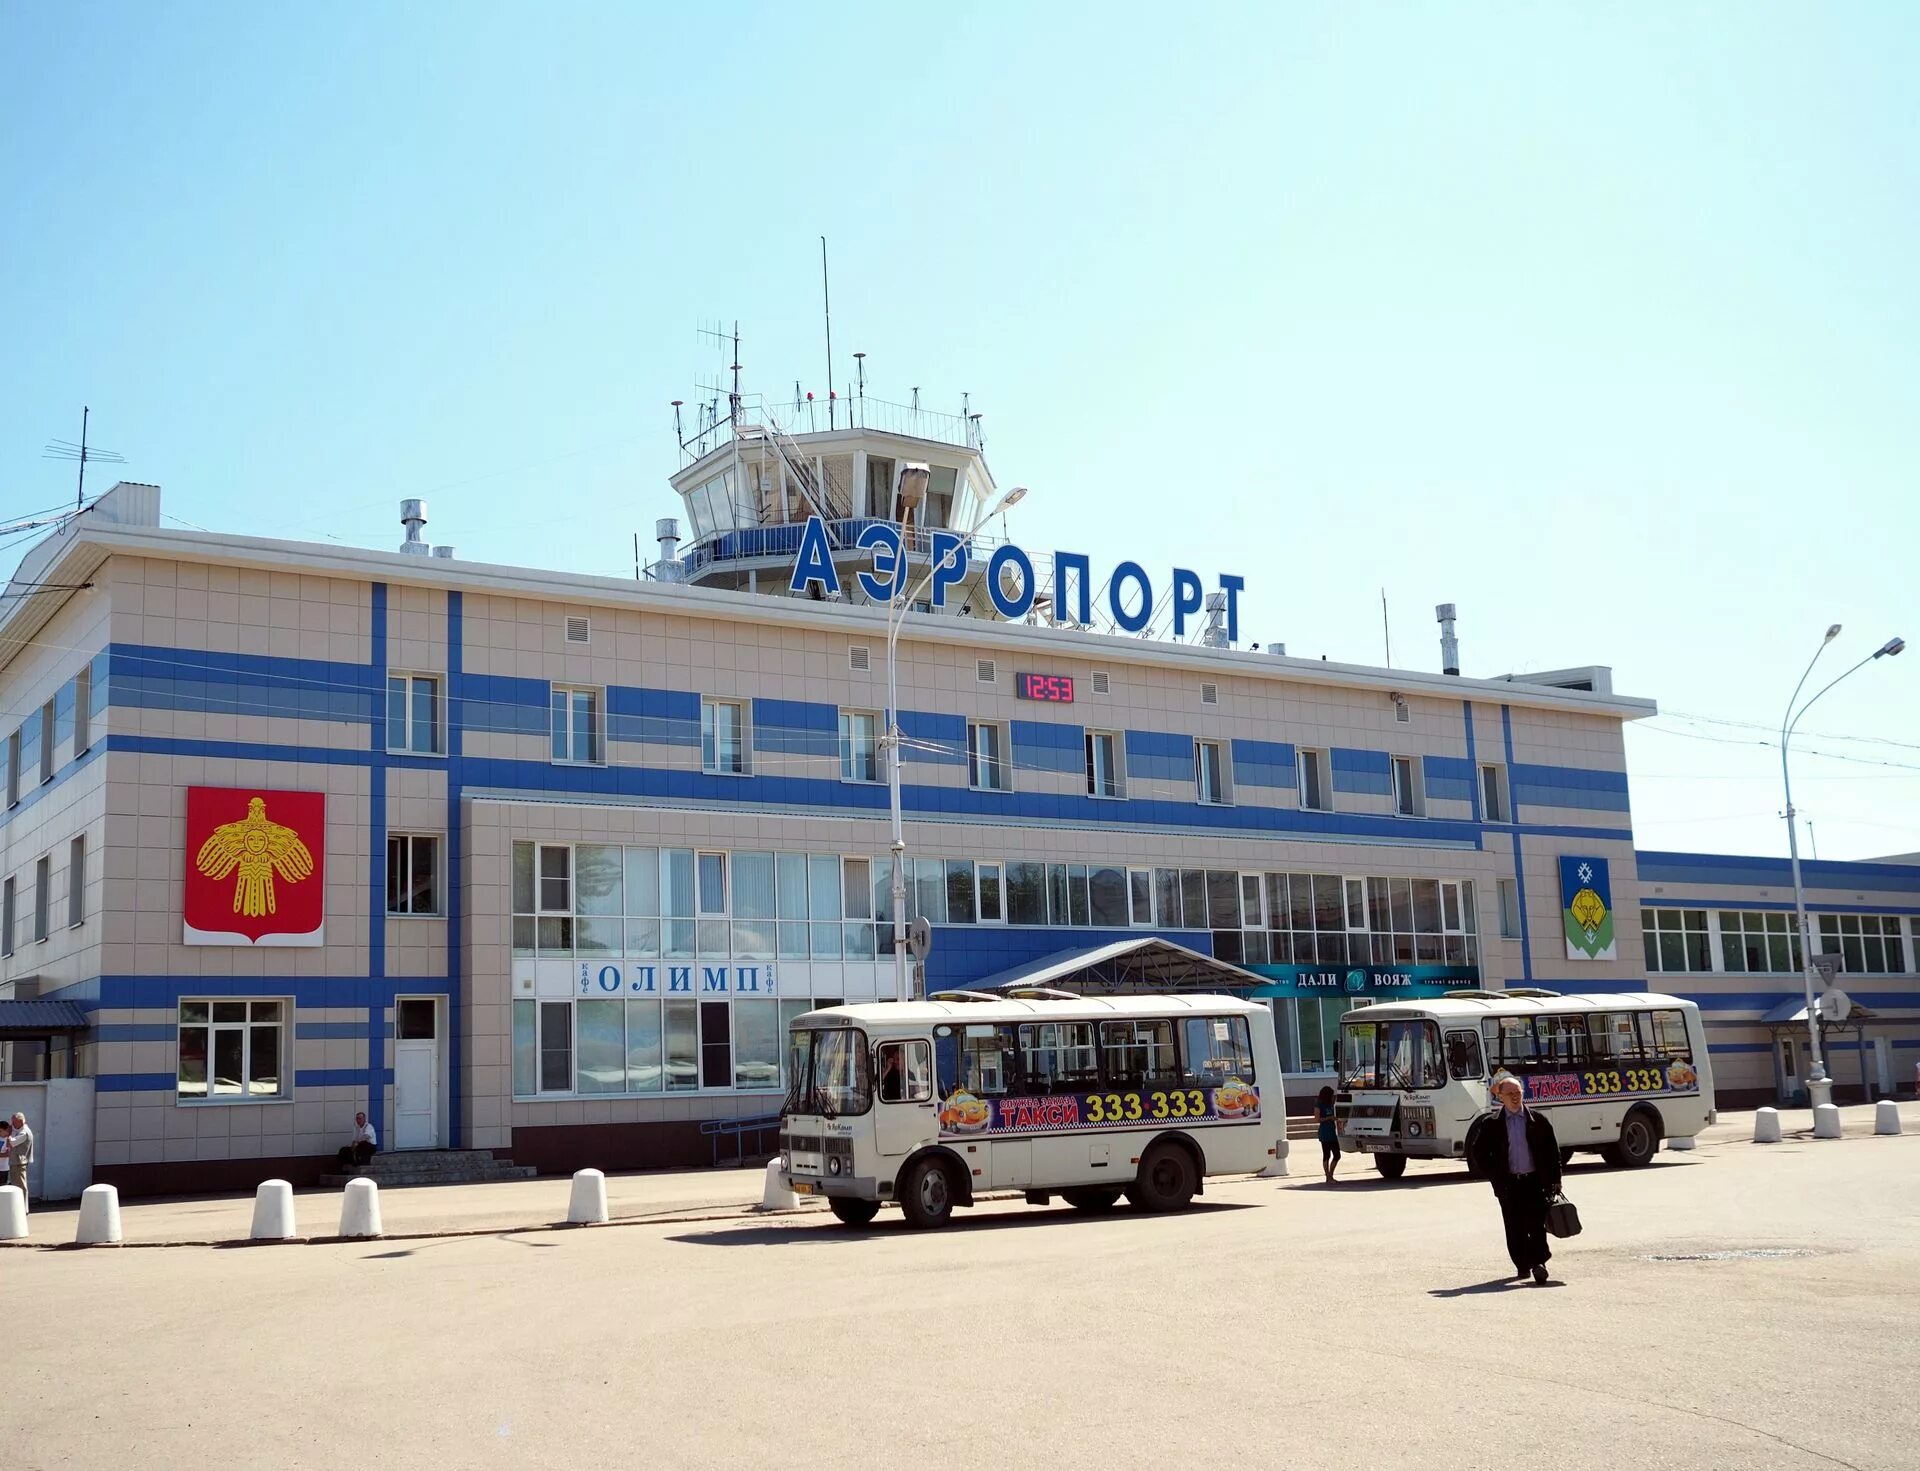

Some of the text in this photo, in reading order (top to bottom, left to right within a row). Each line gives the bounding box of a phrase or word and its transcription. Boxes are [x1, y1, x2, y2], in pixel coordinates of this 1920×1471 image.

[789, 514, 1246, 643] АЭРОПОРТ
[1026, 675, 1073, 701] 12:53
[581, 963, 590, 993] кафе
[598, 965, 760, 992] ОЛИМП
[765, 964, 774, 994] кафе
[1298, 973, 1337, 987] ДАЛИ
[1374, 973, 1413, 987] ВОЯЖ
[1529, 1081, 1581, 1098] ТАКСИ
[1000, 1098, 1040, 1108] СЛУЖБА
[1000, 1104, 1079, 1128] ТАКСИ
